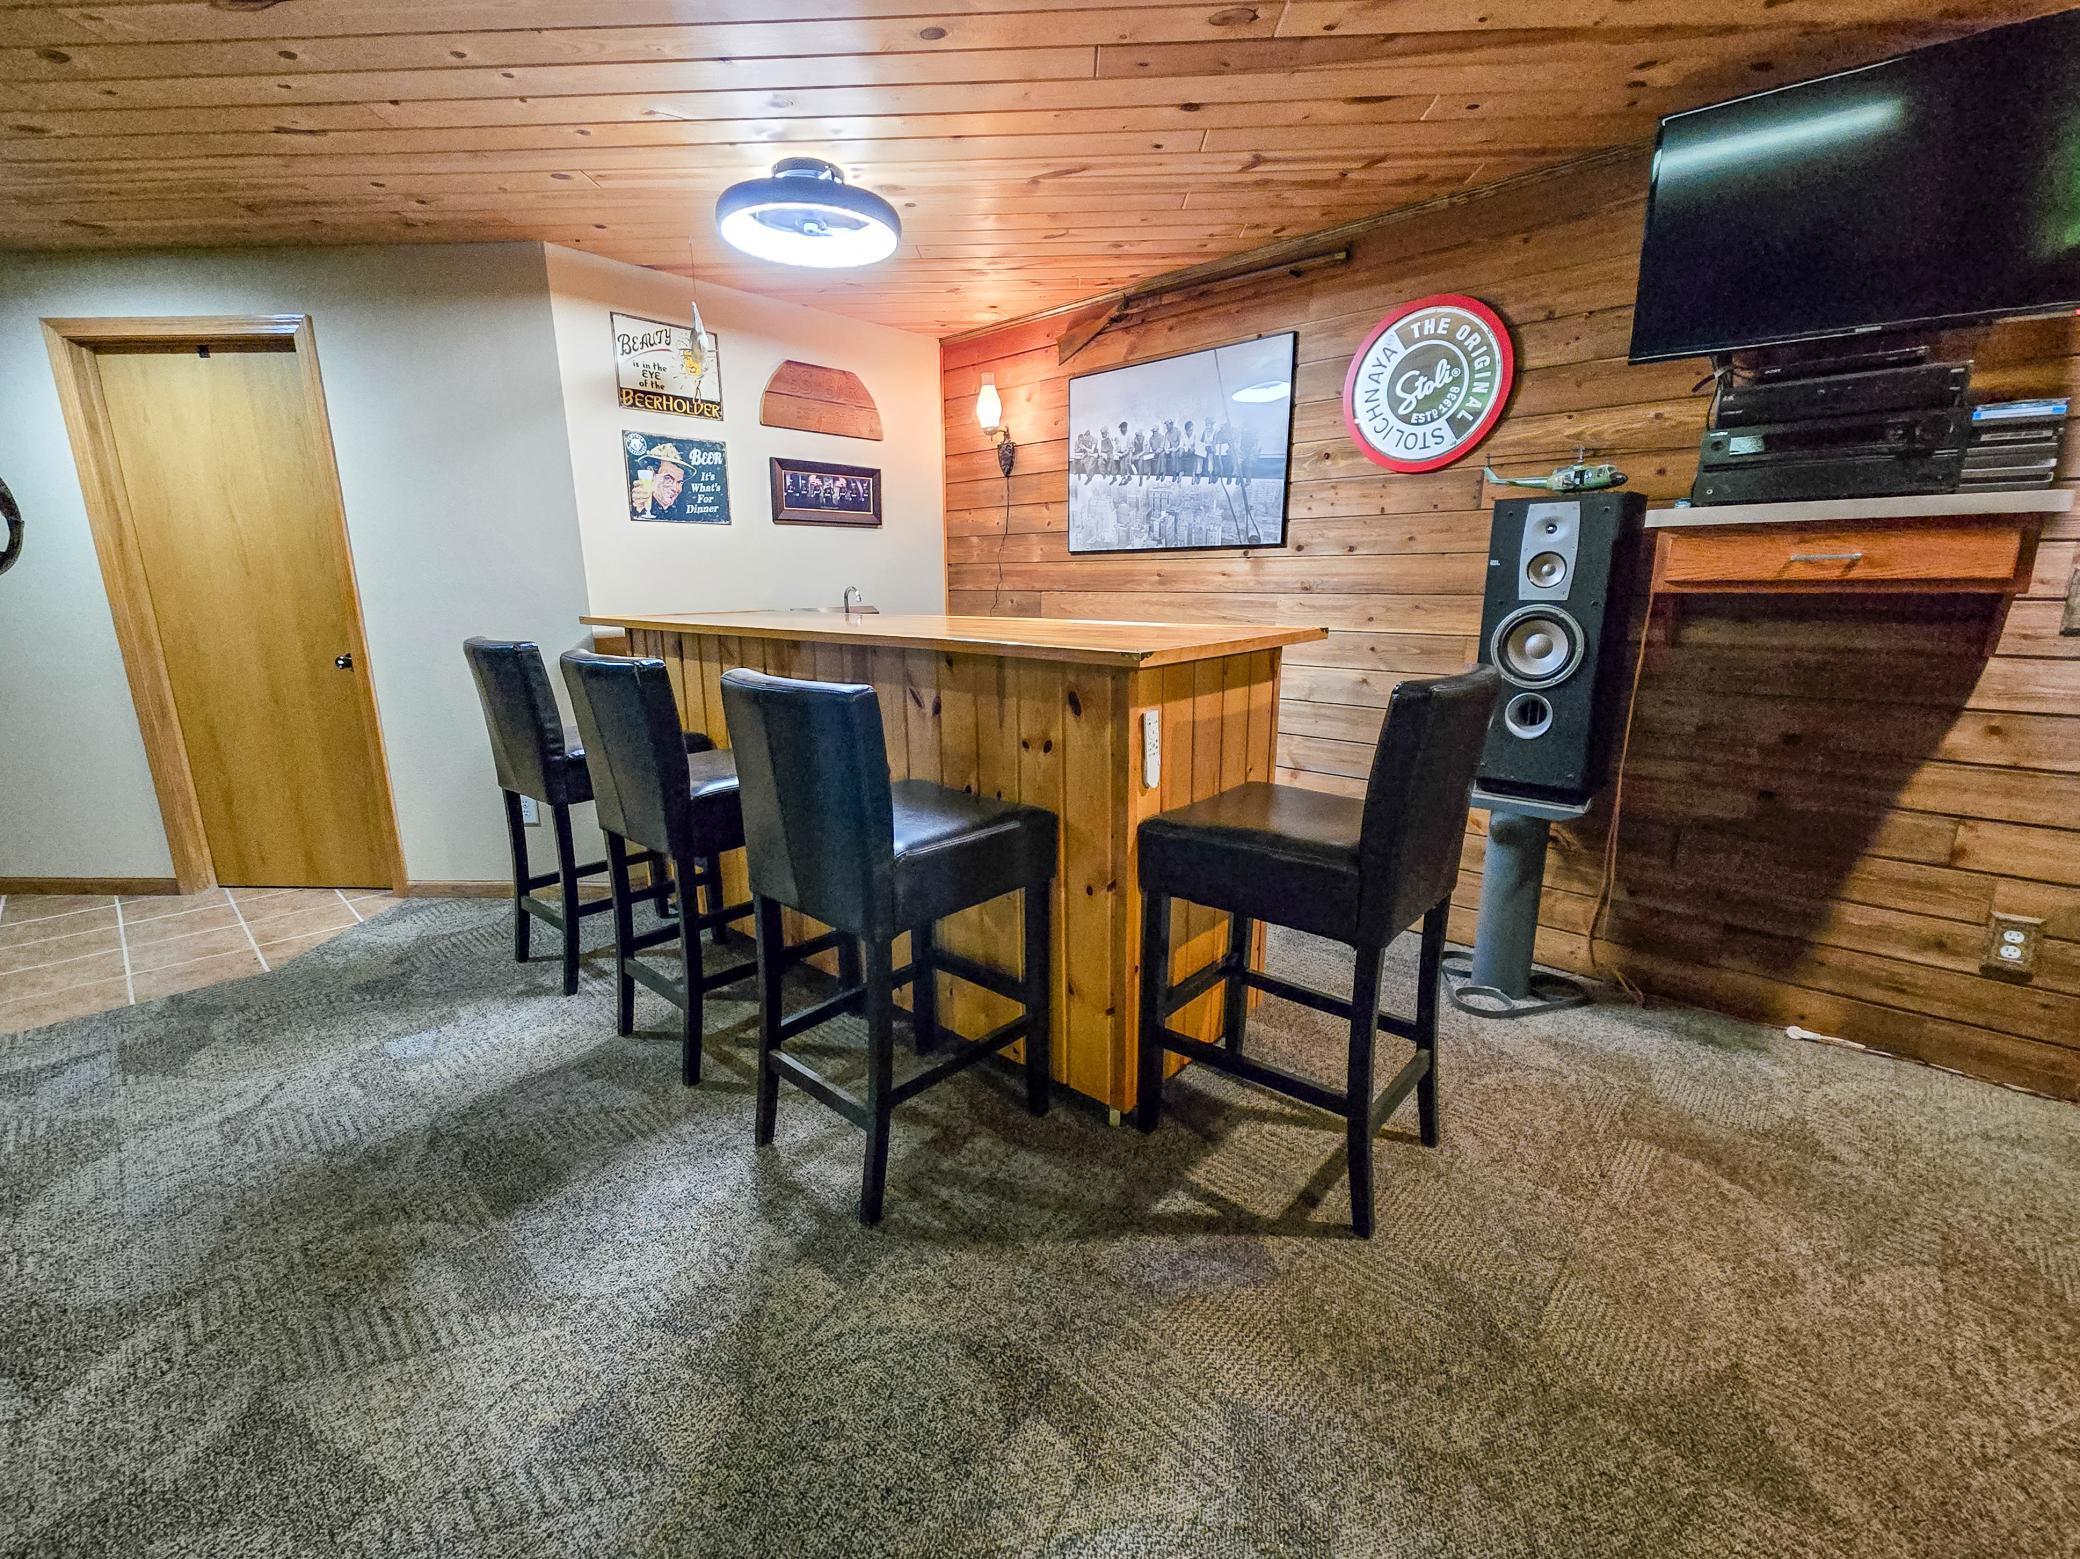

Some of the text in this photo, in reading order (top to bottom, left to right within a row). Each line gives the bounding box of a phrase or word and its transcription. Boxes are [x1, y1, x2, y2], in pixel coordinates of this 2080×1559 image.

[617, 328, 671, 356] BEAUTY
[642, 361, 651, 370] in
[653, 362, 667, 372] the
[1410, 317, 1451, 338] THE
[1455, 324, 1491, 421] ORIGINAL
[642, 370, 661, 380] EYE
[639, 380, 665, 390] of the
[1395, 358, 1453, 415] Stoli
[621, 388, 720, 418] BEERHOLDER
[1364, 347, 1445, 450] STOLICHNAYA
[1438, 386, 1460, 412] 1938
[701, 472, 715, 481] It's
[691, 483, 721, 493] What's
[697, 494, 714, 503] For
[686, 504, 719, 514] Dinner
